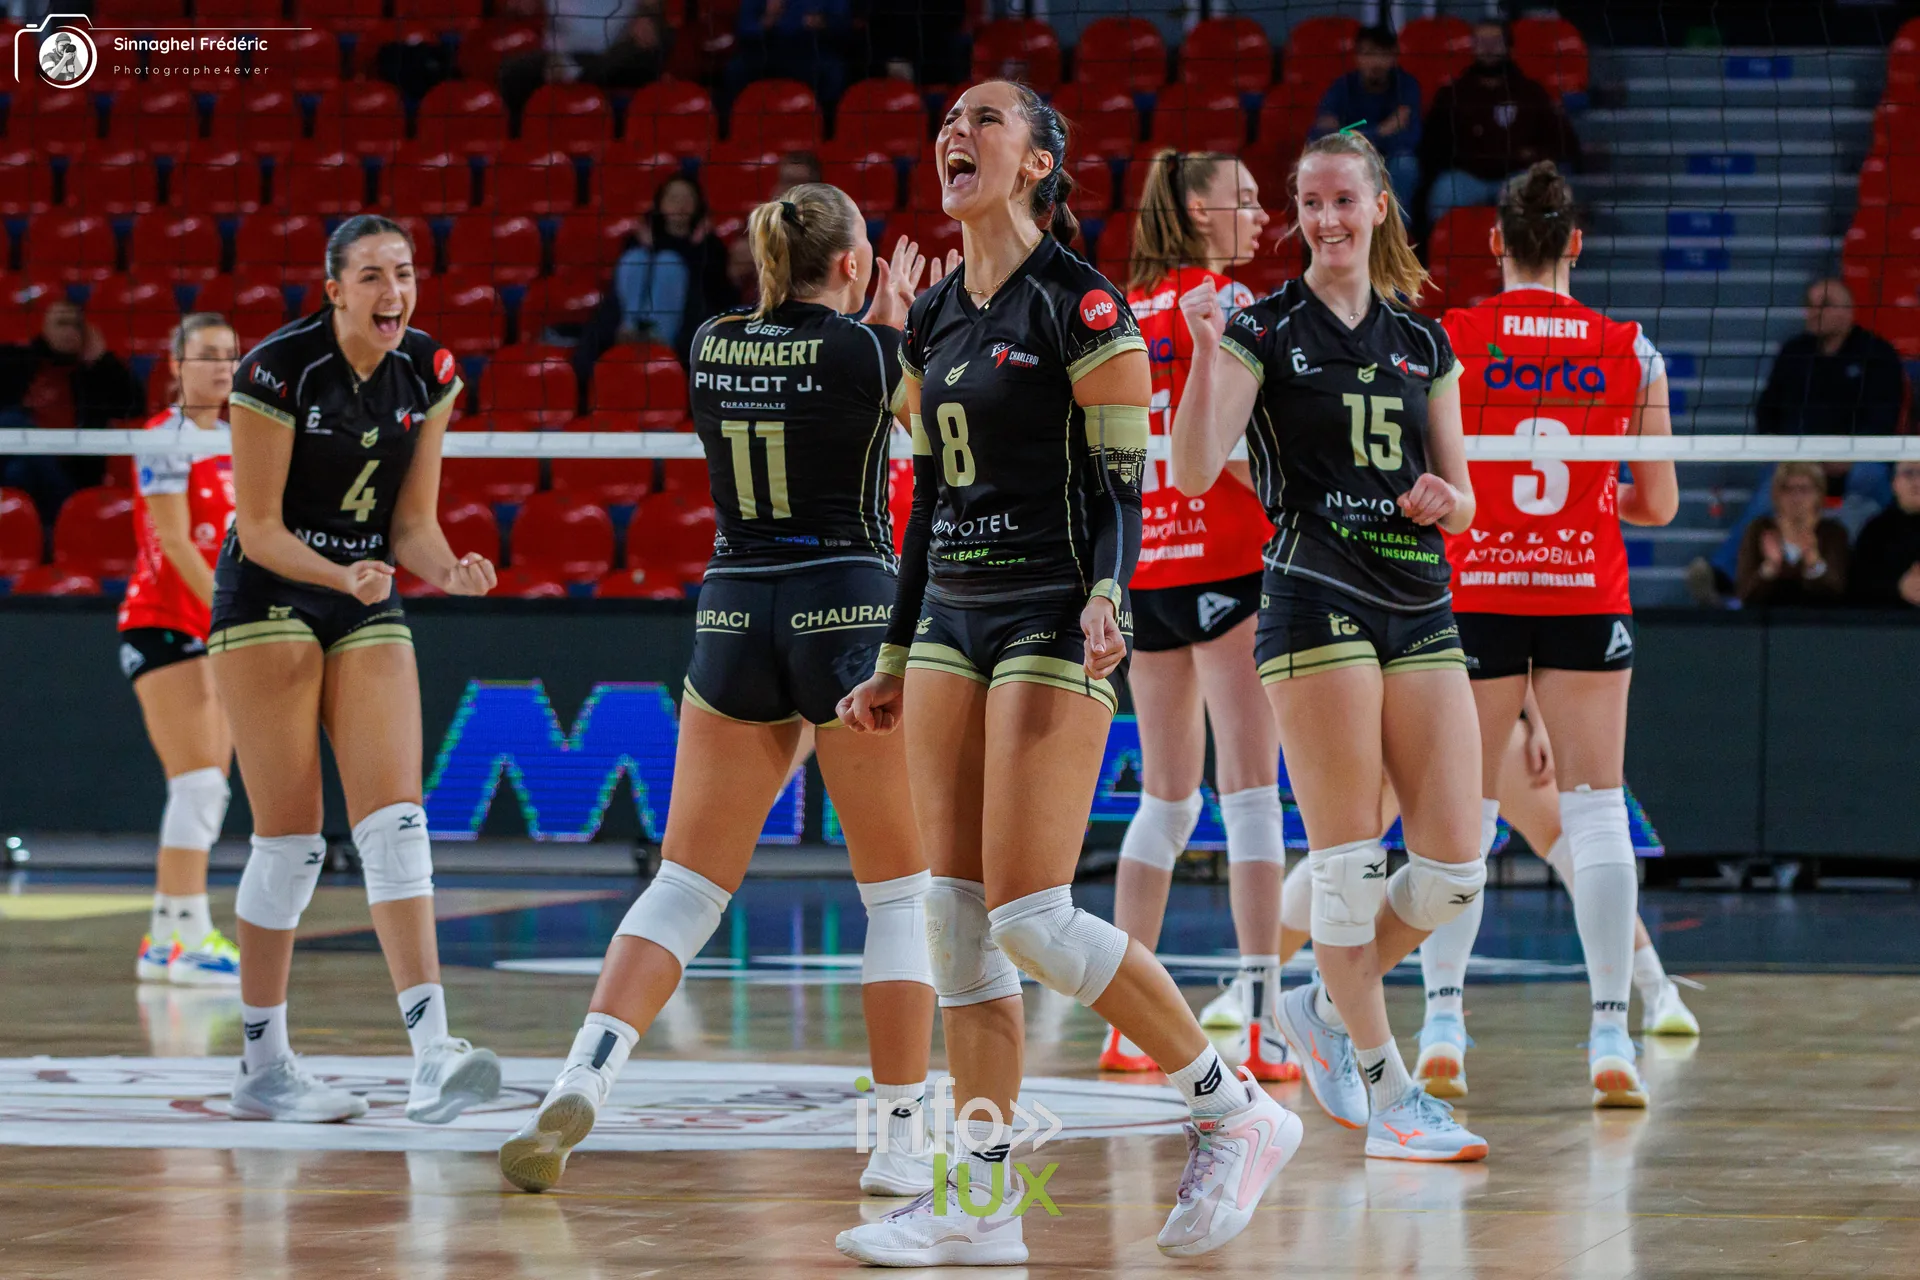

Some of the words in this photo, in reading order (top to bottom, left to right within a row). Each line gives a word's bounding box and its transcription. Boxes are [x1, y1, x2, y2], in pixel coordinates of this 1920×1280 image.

[1503, 315, 1589, 339] FLAMENT
[699, 335, 823, 367] HANNAERT
[695, 372, 787, 393] PIRLOT
[797, 375, 823, 392] J.
[1484, 356, 1605, 393] darta
[936, 402, 976, 488] 8
[1342, 393, 1404, 471] 15
[721, 420, 792, 520] 11
[1512, 416, 1570, 516] 3
[341, 459, 381, 522] 4
[1380, 533, 1418, 546] LEASE
[1469, 528, 1595, 544] VOLVO
[1381, 547, 1440, 565] INSURANCE
